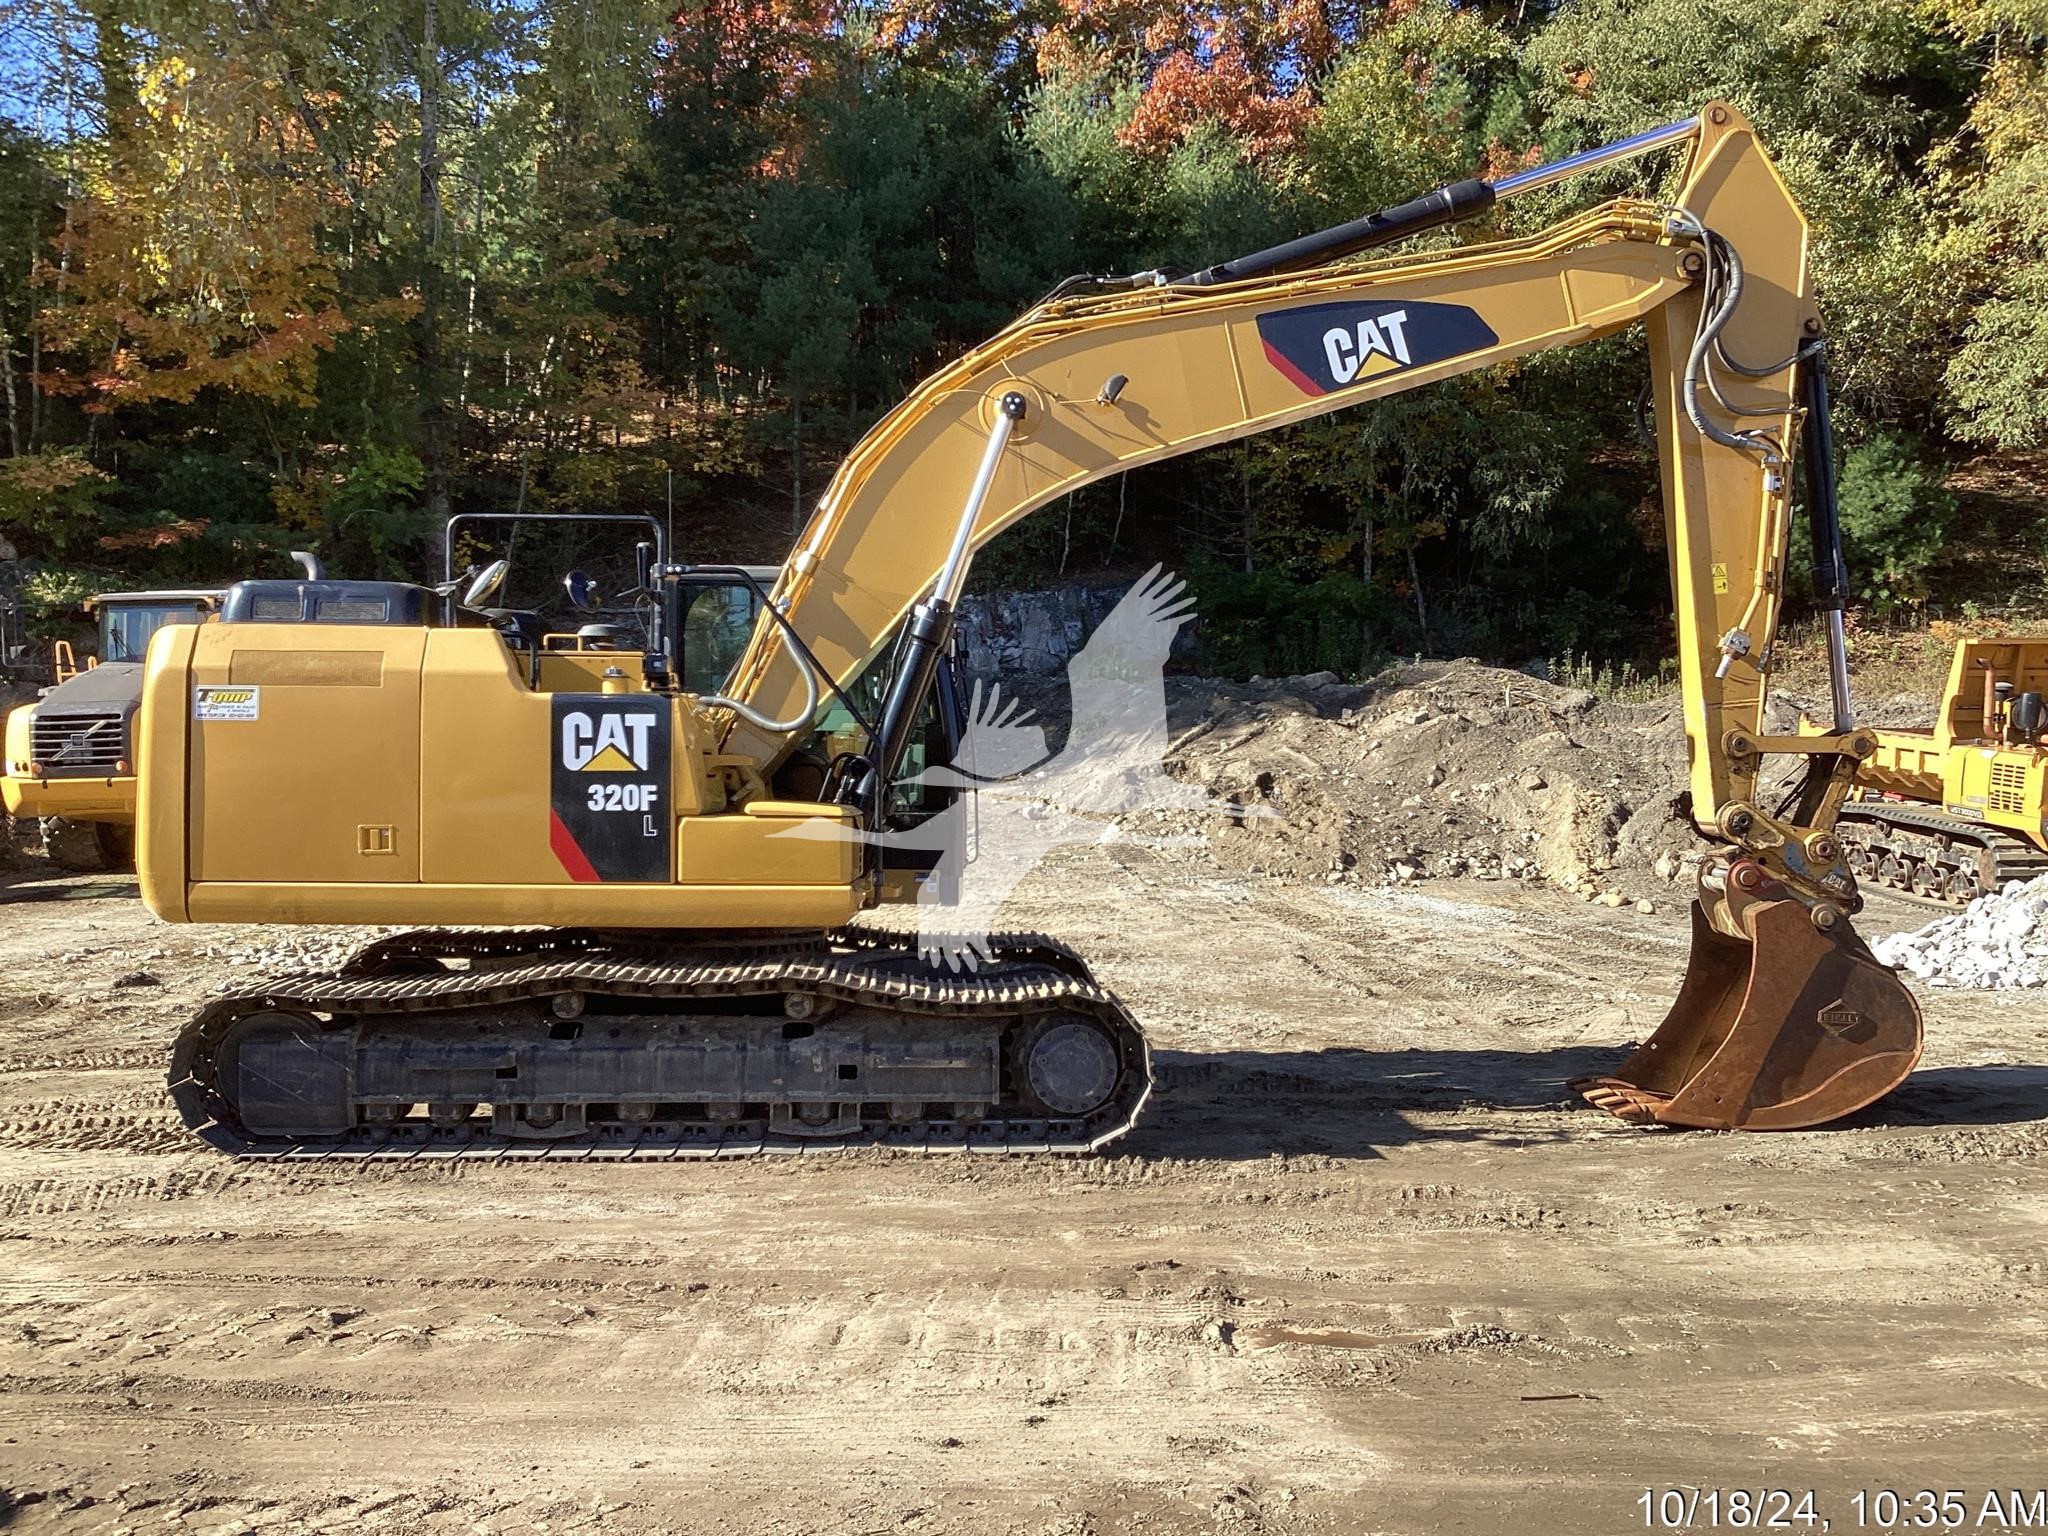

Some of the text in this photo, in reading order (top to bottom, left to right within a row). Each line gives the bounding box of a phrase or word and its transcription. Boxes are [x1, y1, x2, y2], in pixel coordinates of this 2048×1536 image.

[1323, 310, 1410, 384] CAT
[563, 712, 656, 771] CAT
[588, 784, 657, 811] 320F
[643, 815, 657, 836] L
